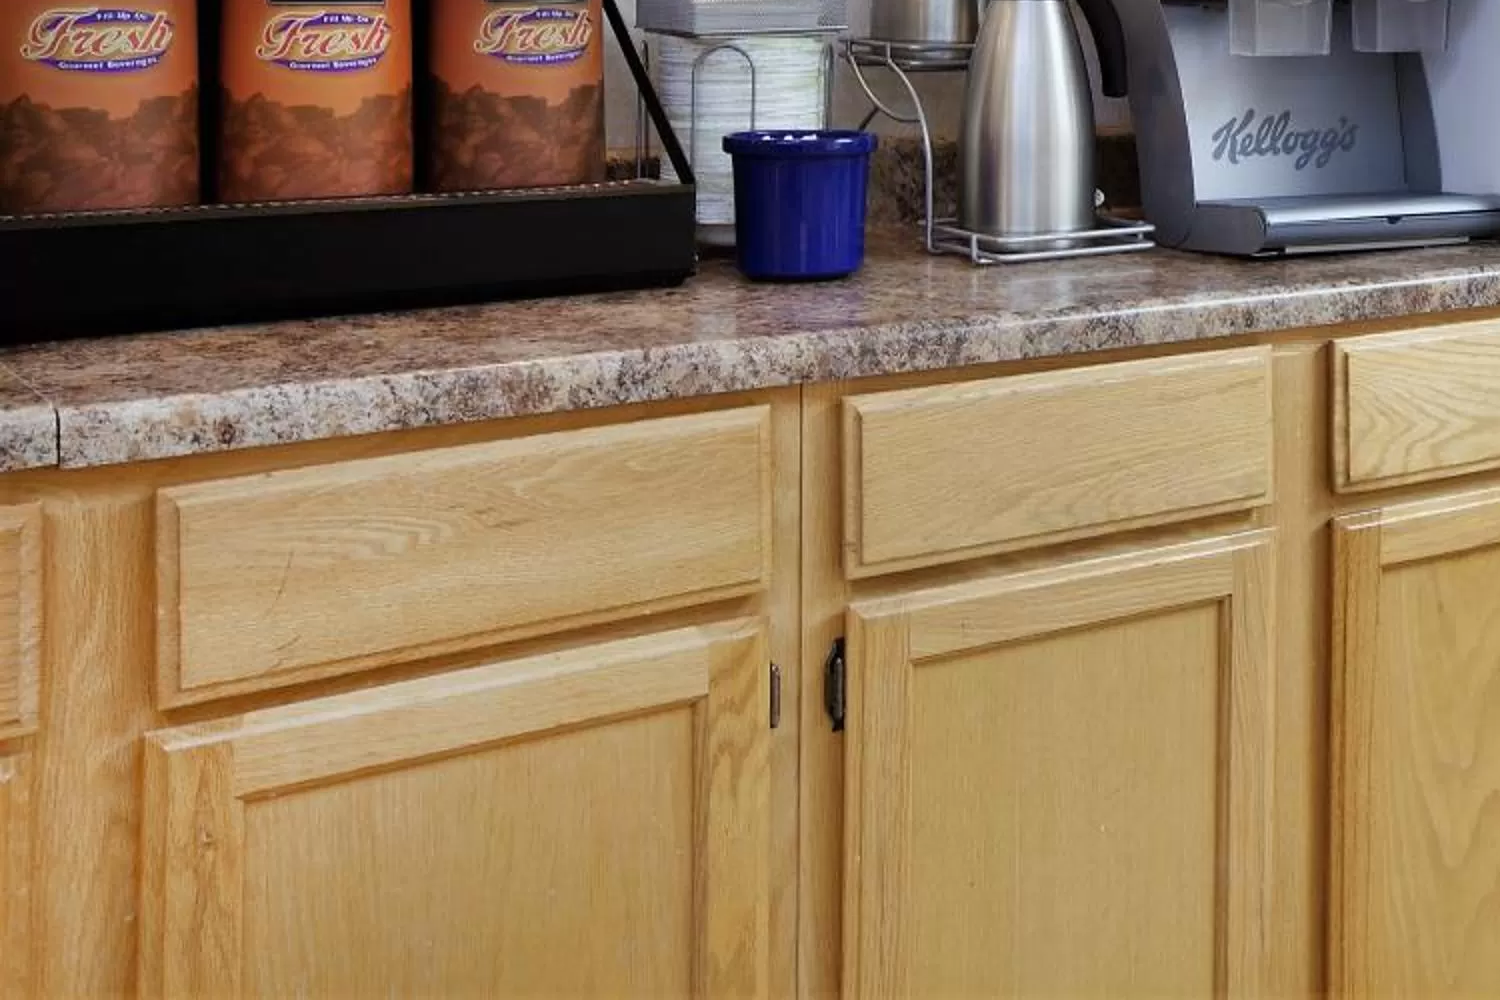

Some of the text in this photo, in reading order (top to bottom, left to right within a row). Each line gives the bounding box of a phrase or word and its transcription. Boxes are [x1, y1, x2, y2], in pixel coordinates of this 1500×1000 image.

[20, 7, 173, 59] Fresh
[255, 10, 391, 59] Fresh
[473, 6, 592, 53] Fresh
[1212, 108, 1360, 170] Kellogg's
